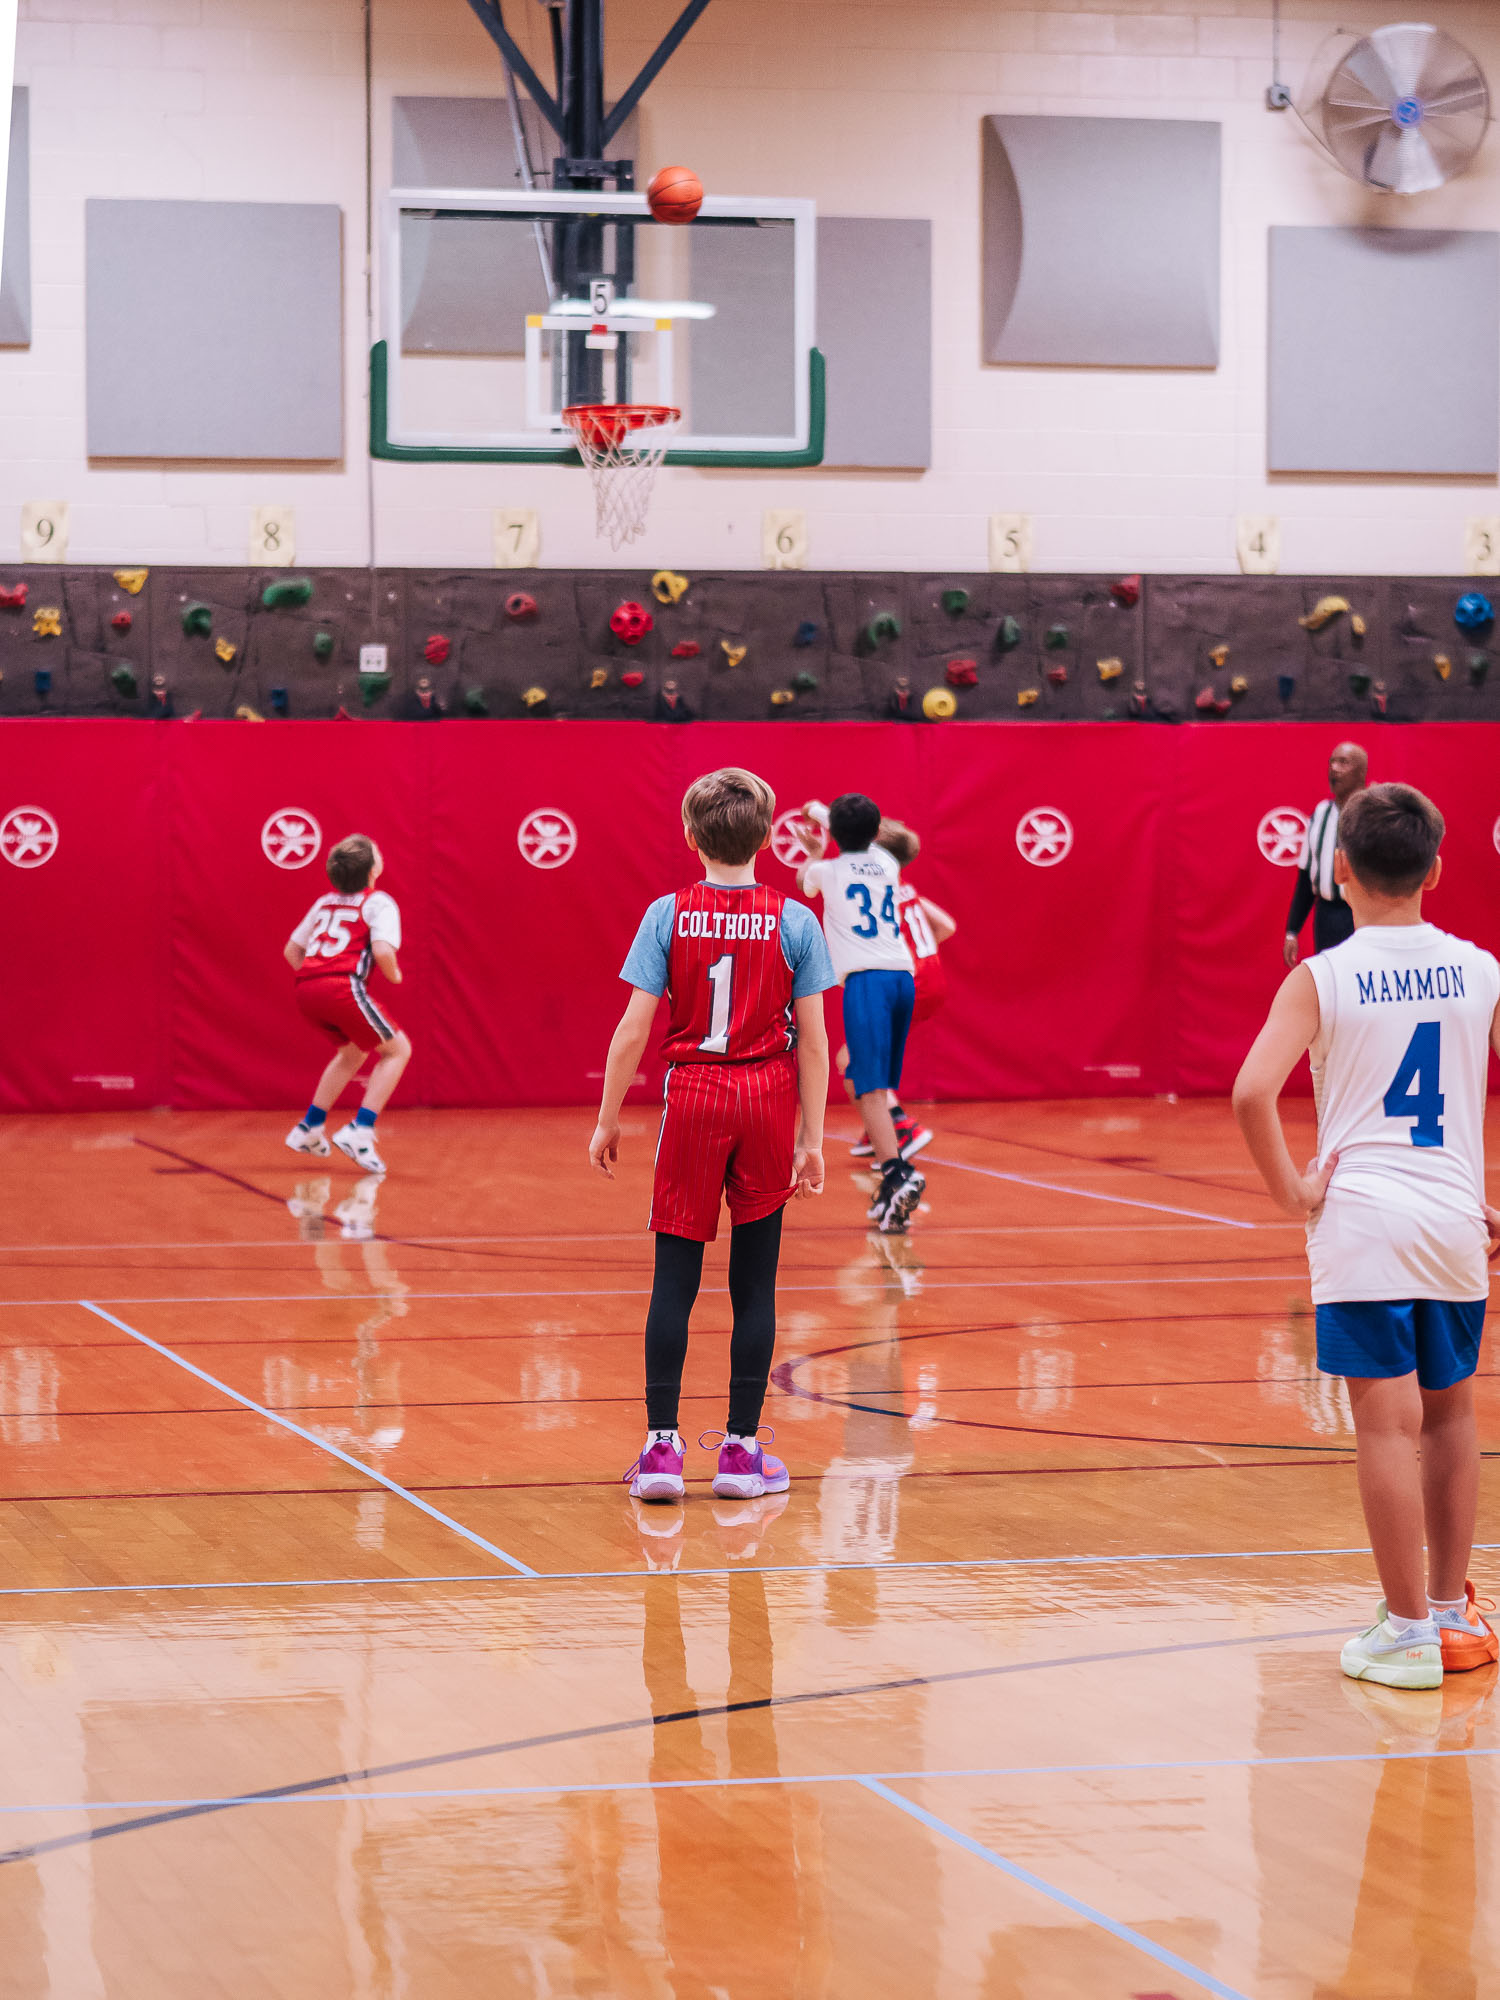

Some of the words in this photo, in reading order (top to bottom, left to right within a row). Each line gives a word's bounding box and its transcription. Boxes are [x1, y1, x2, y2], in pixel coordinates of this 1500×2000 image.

[594, 284, 607, 315] 5
[37, 519, 54, 548] 9
[264, 522, 280, 551] 8
[508, 524, 523, 553] 7
[776, 525, 794, 554] 6
[1003, 530, 1019, 558] 5
[1248, 531, 1266, 558] 4
[1477, 532, 1491, 561] 3
[678, 911, 776, 940] COLTHORP
[845, 883, 900, 939] 34
[305, 908, 359, 957] 25
[904, 904, 937, 959] 11
[1355, 965, 1466, 1006] MAMMON
[697, 954, 734, 1056] 1
[1383, 1021, 1445, 1148] 4
